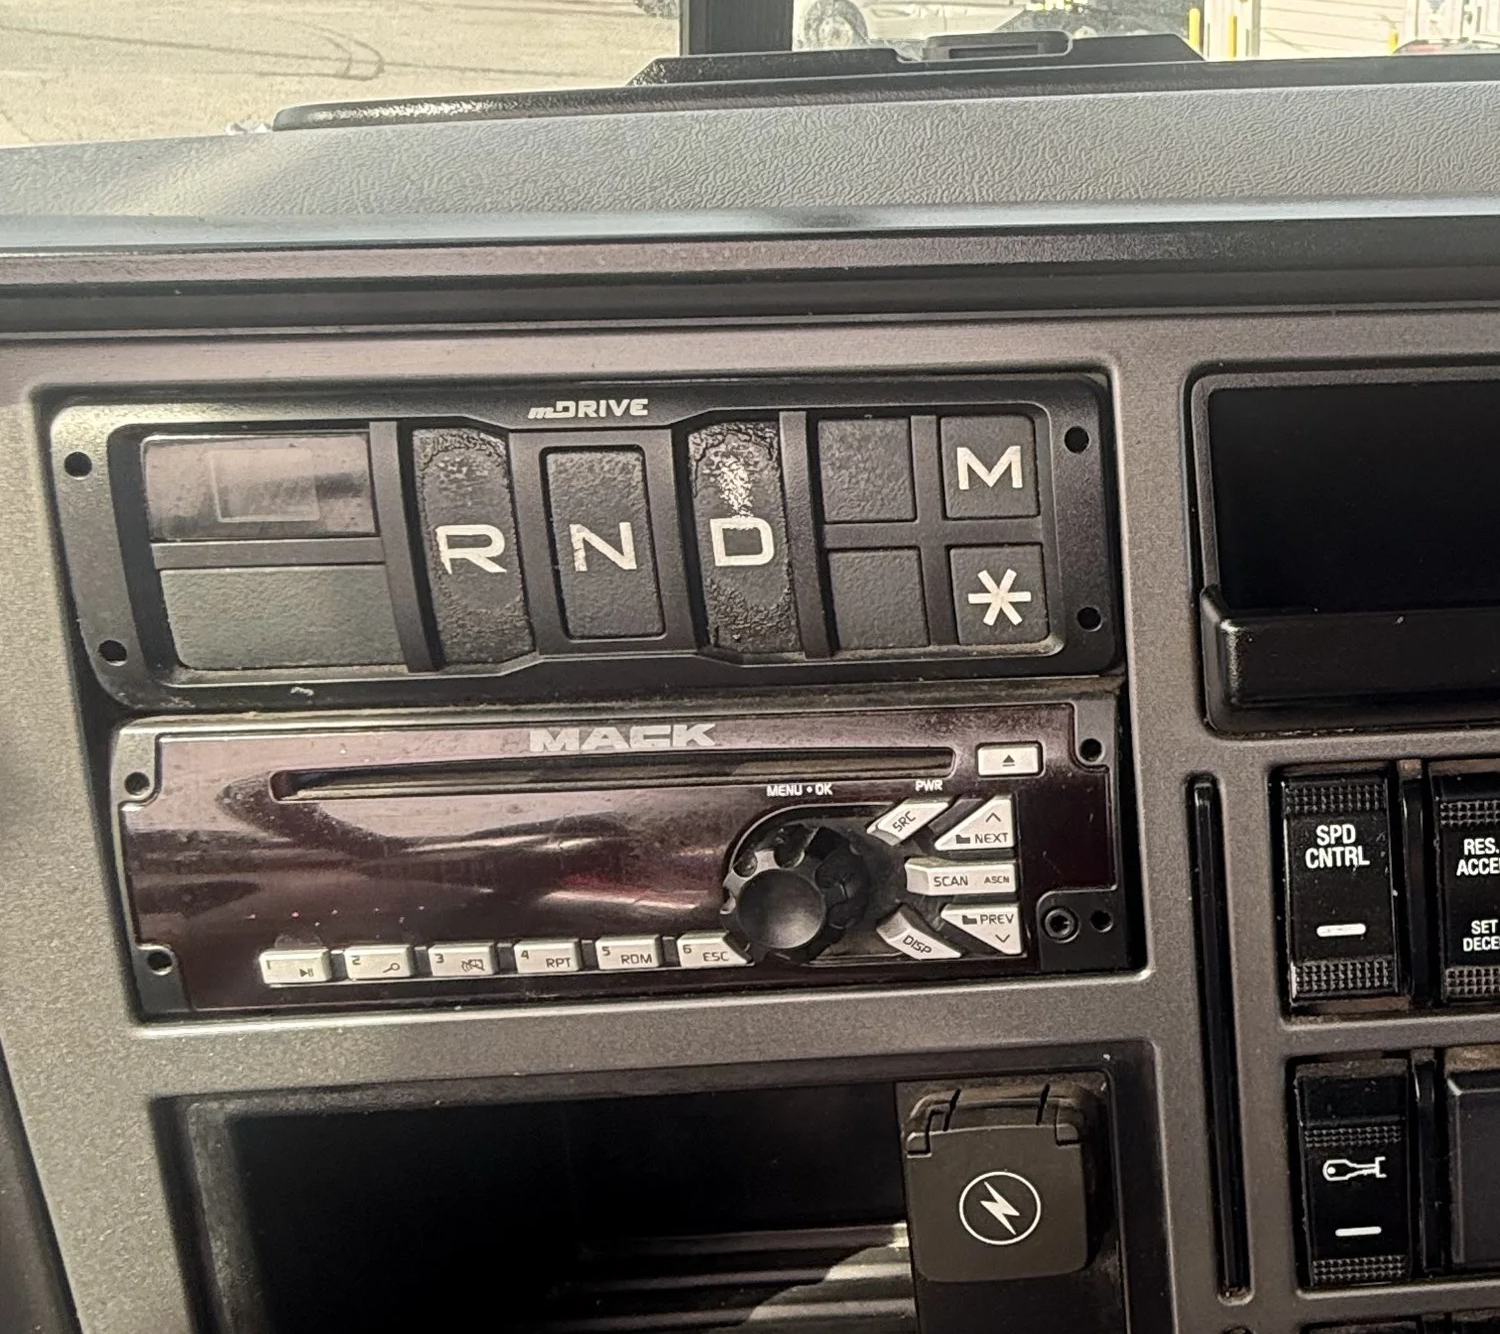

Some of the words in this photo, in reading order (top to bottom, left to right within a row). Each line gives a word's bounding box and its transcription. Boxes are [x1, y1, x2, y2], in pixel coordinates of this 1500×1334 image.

[528, 398, 648, 419] mDRIVE
[957, 446, 1024, 489] M
[435, 524, 507, 573] R
[569, 522, 637, 572] N
[709, 517, 775, 567] D
[529, 724, 716, 752] MACK
[767, 784, 802, 797] MENU
[815, 783, 833, 796] OK
[915, 779, 943, 792] PWR
[892, 810, 917, 833] SRC
[974, 832, 1009, 844] NEXT
[1316, 824, 1356, 846] SPD
[1463, 837, 1500, 856] RES.
[1305, 845, 1370, 869] CNTRL
[933, 875, 969, 887] SCAN
[980, 914, 1015, 925] PREV
[1470, 919, 1498, 935] SET
[601, 946, 611, 957] 5
[683, 944, 692, 955] 6
[902, 934, 932, 955] DISP
[352, 955, 362, 966] 2
[434, 953, 444, 964] 3
[520, 949, 530, 960] 4
[620, 953, 652, 965] RDM
[702, 951, 730, 963] ESC
[545, 957, 571, 969] RPT
